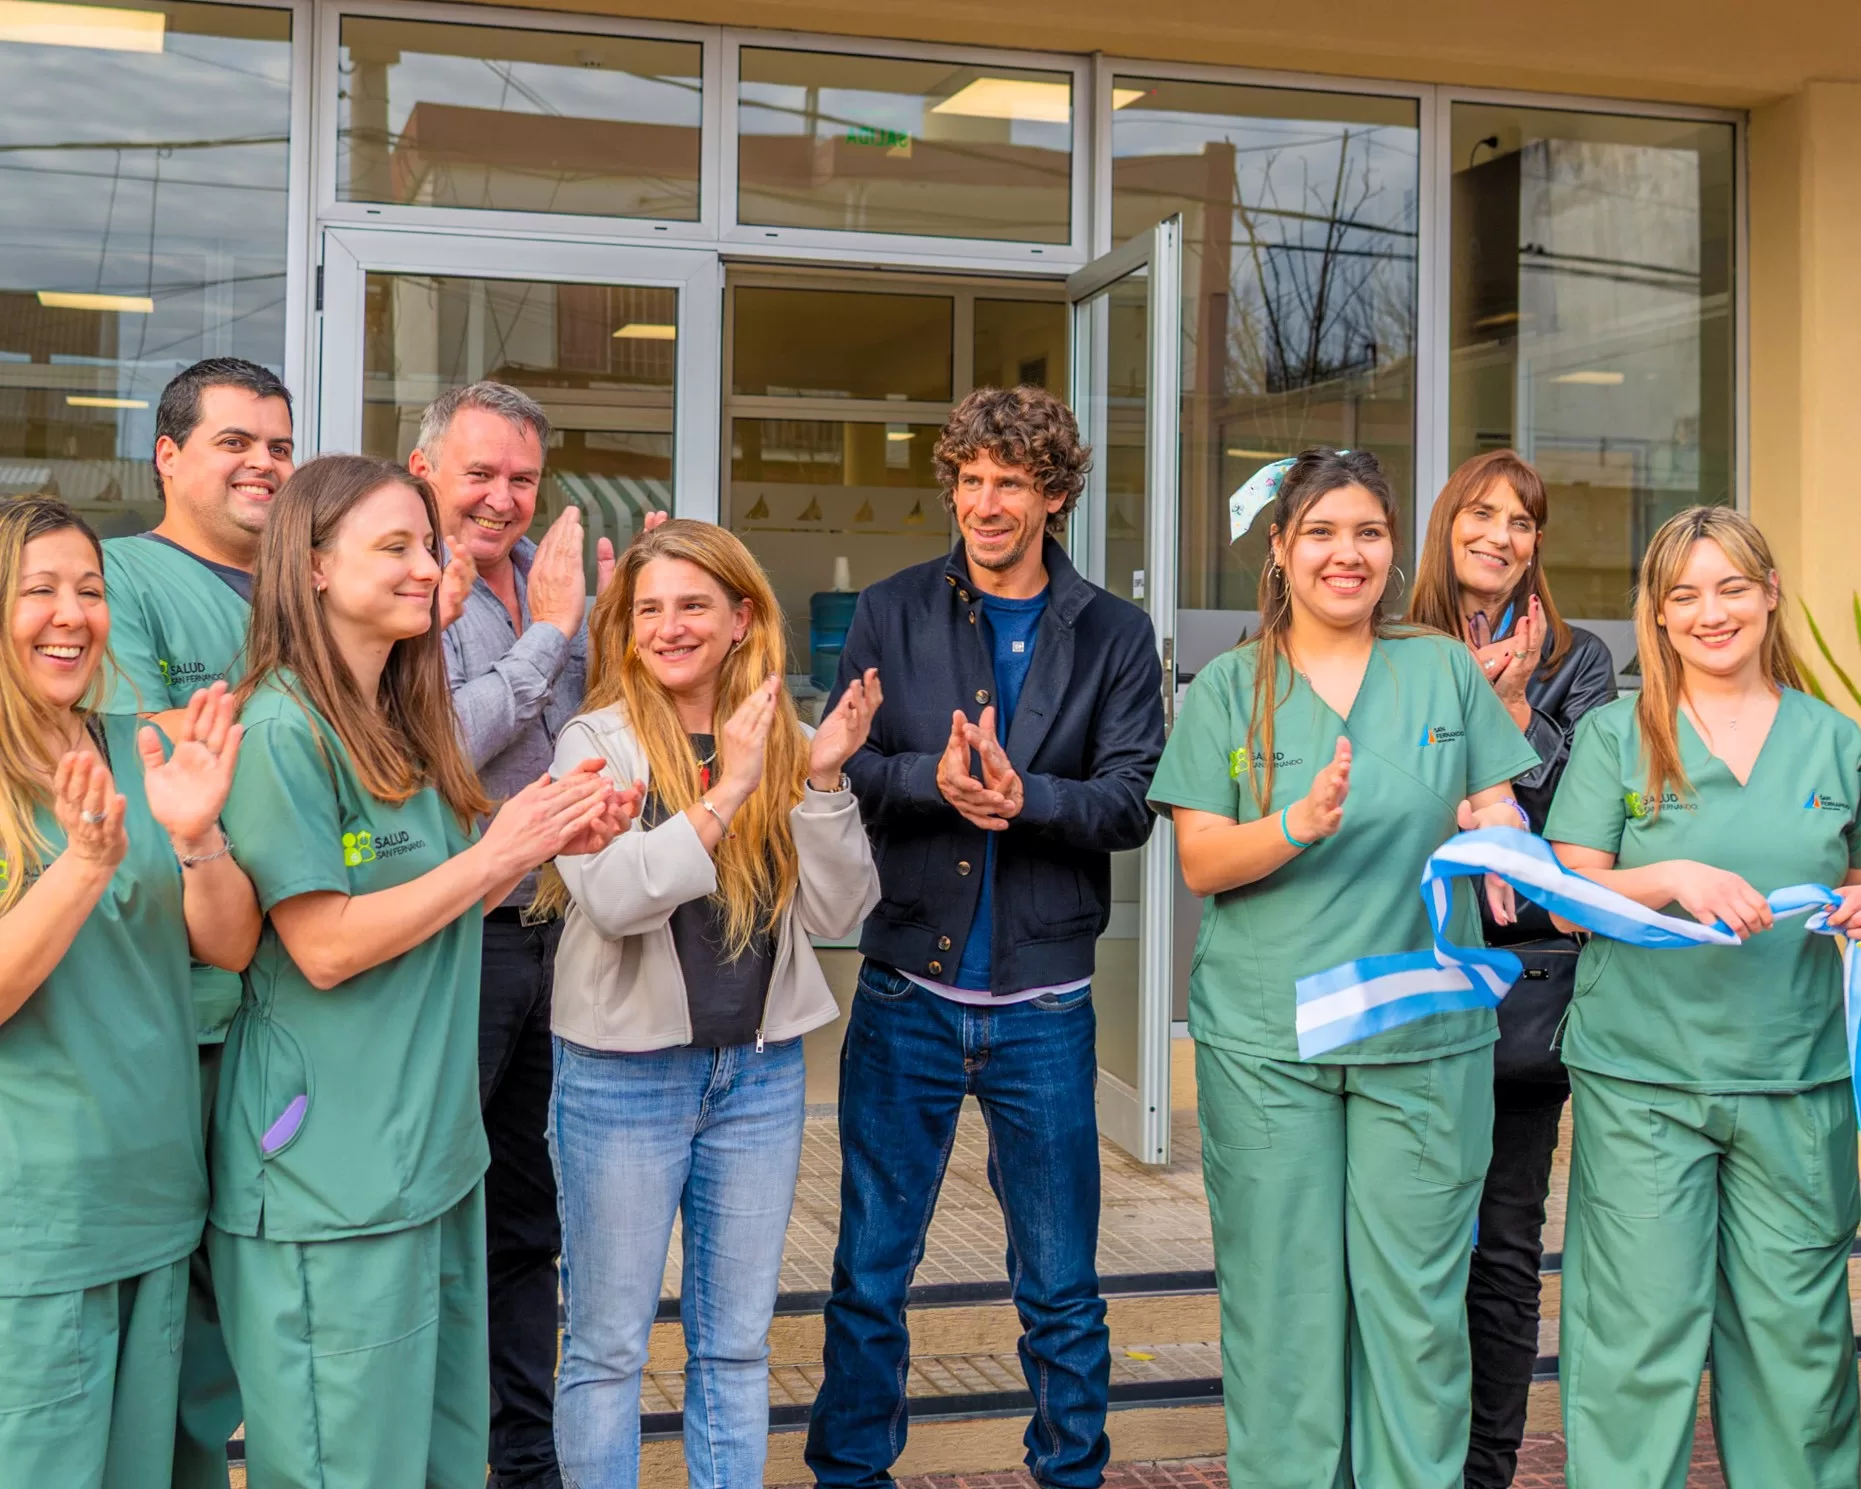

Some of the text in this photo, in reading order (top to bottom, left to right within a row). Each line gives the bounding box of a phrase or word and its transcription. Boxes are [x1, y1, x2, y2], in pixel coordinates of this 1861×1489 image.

[170, 662, 206, 676] SALUD
[171, 672, 225, 686] SAN FERNANDO
[374, 831, 410, 849] SALUD
[376, 840, 426, 860] SAN FERNANDO
